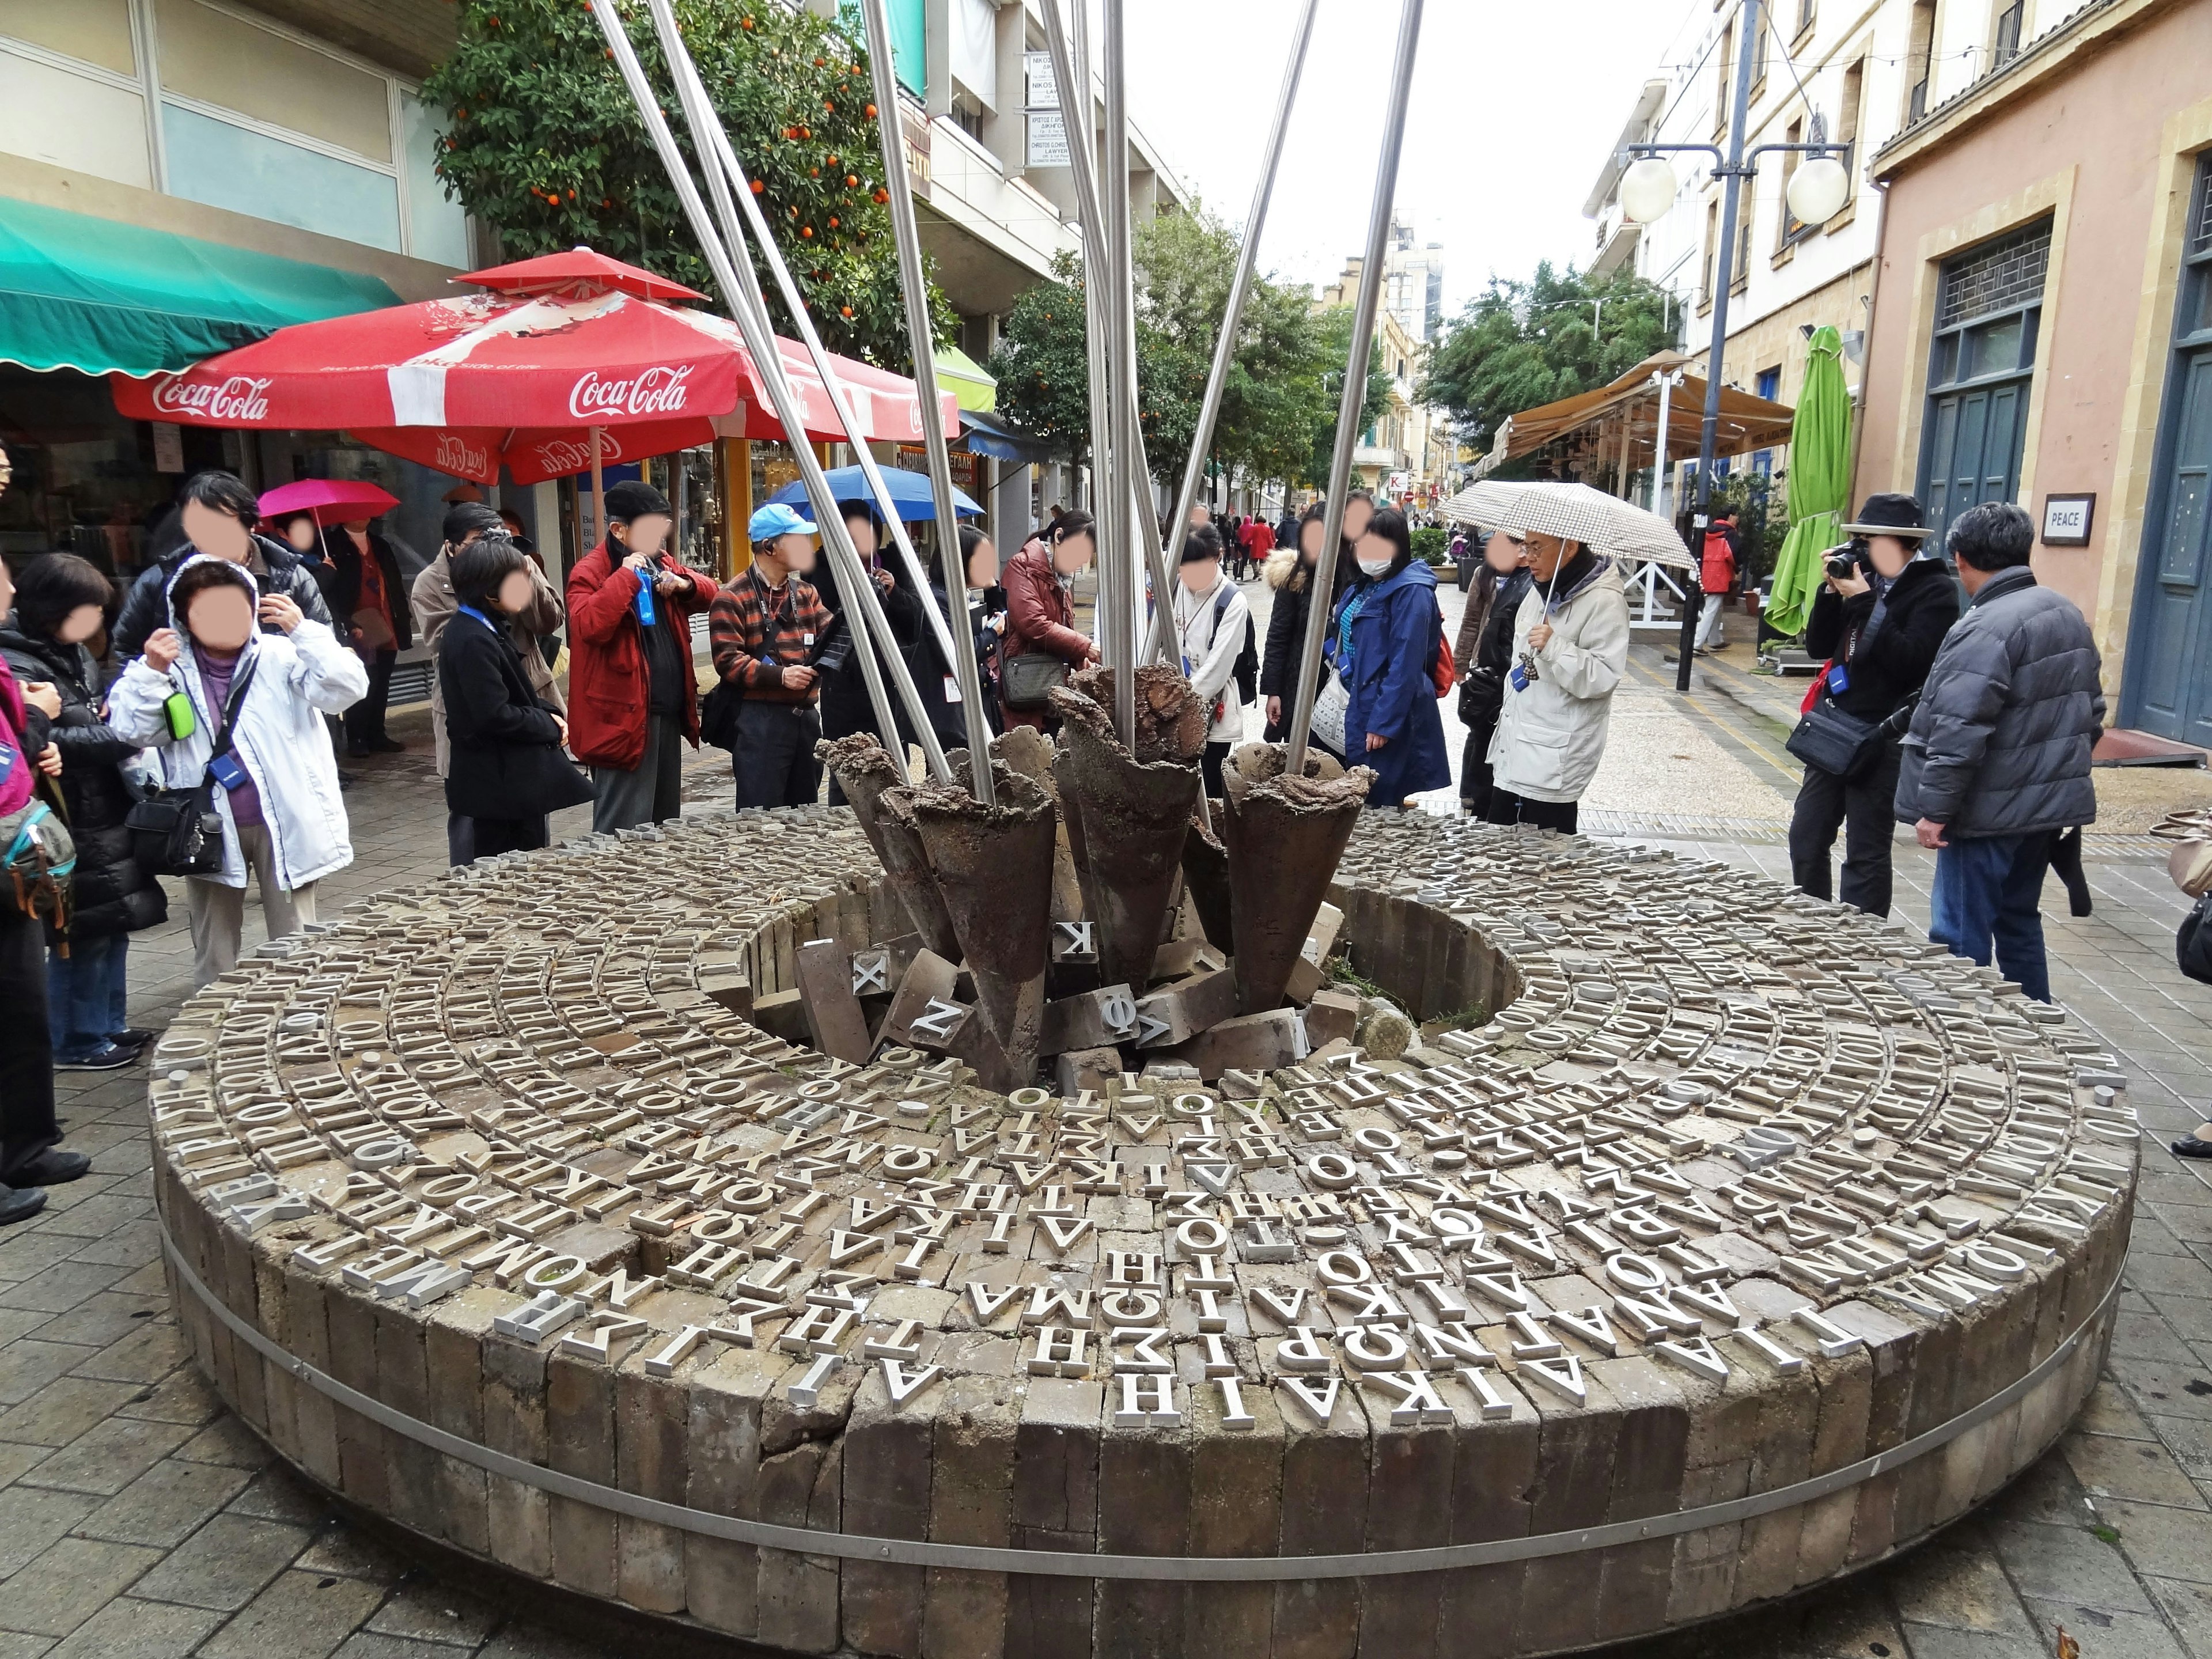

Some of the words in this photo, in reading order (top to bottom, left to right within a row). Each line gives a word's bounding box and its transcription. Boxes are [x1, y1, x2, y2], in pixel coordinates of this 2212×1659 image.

[153, 374, 274, 421] Coca-Cola
[569, 363, 696, 418] Coca-Cola
[949, 454, 972, 469] ΕΓΑΛΗ
[2051, 512, 2080, 527] PEACE
